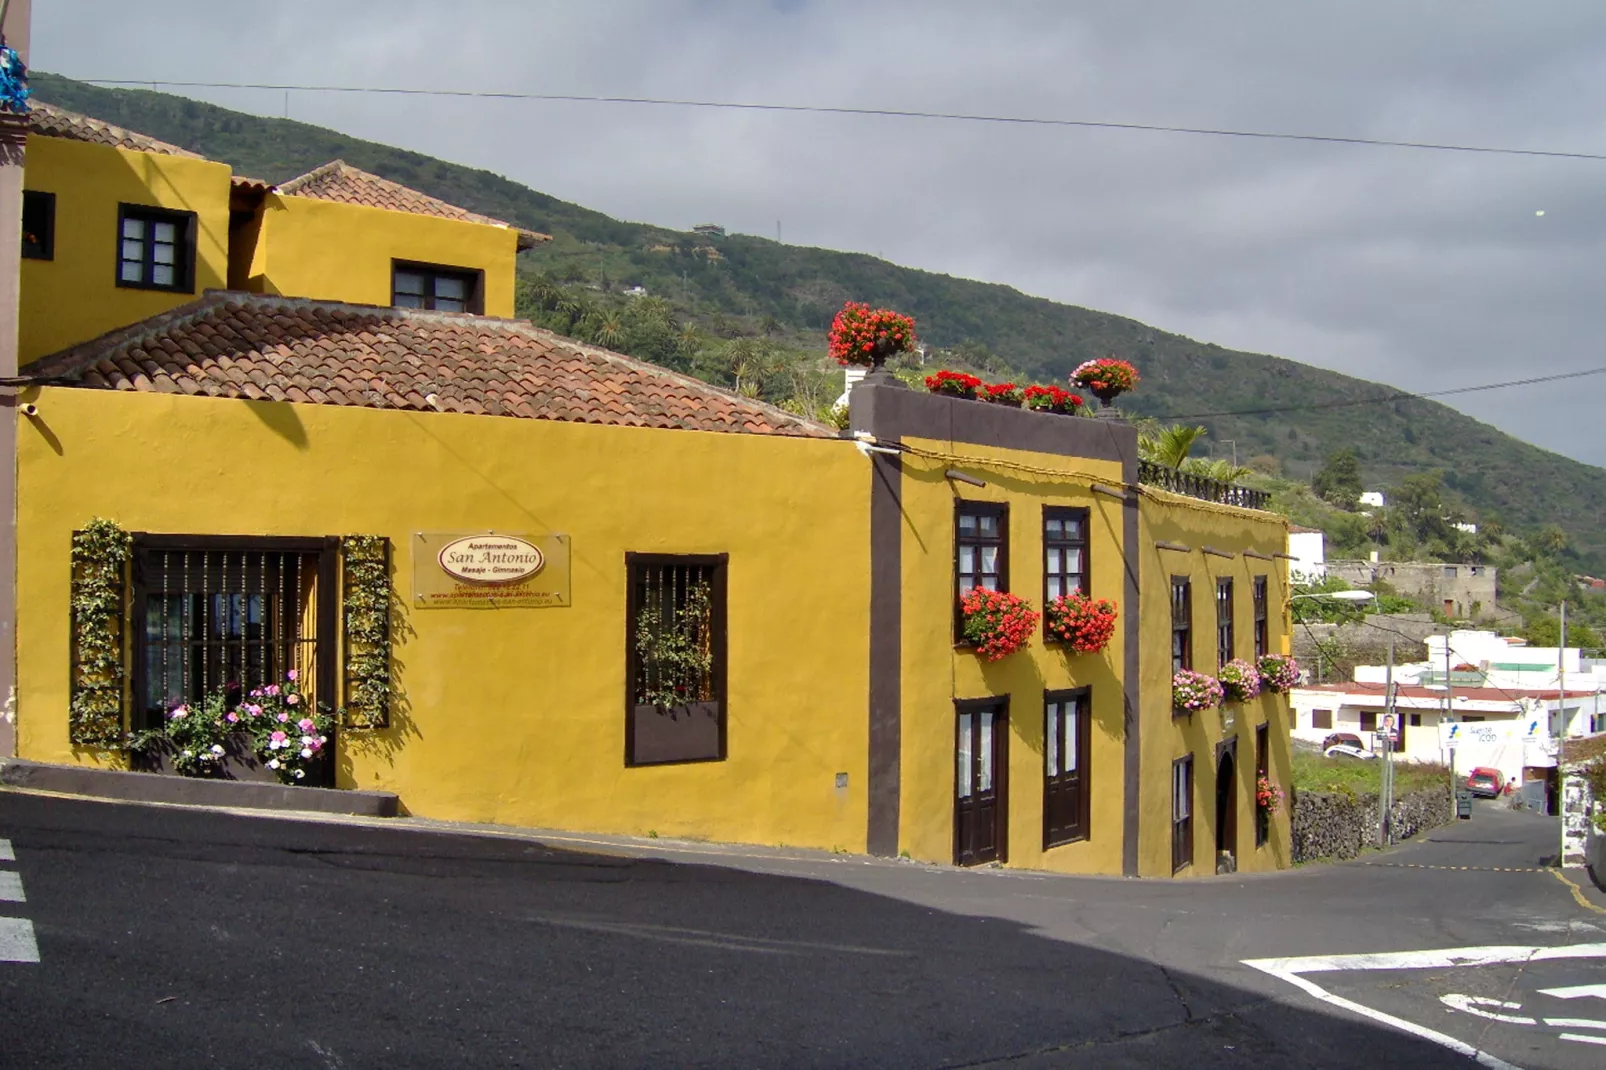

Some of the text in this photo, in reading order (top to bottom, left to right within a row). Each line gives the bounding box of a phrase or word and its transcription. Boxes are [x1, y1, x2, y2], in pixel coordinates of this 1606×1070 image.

[468, 543, 518, 551] Apartamentos
[447, 551, 537, 564] San Antonio
[461, 566, 486, 574] Masaje
[492, 566, 525, 574] Gimnasio
